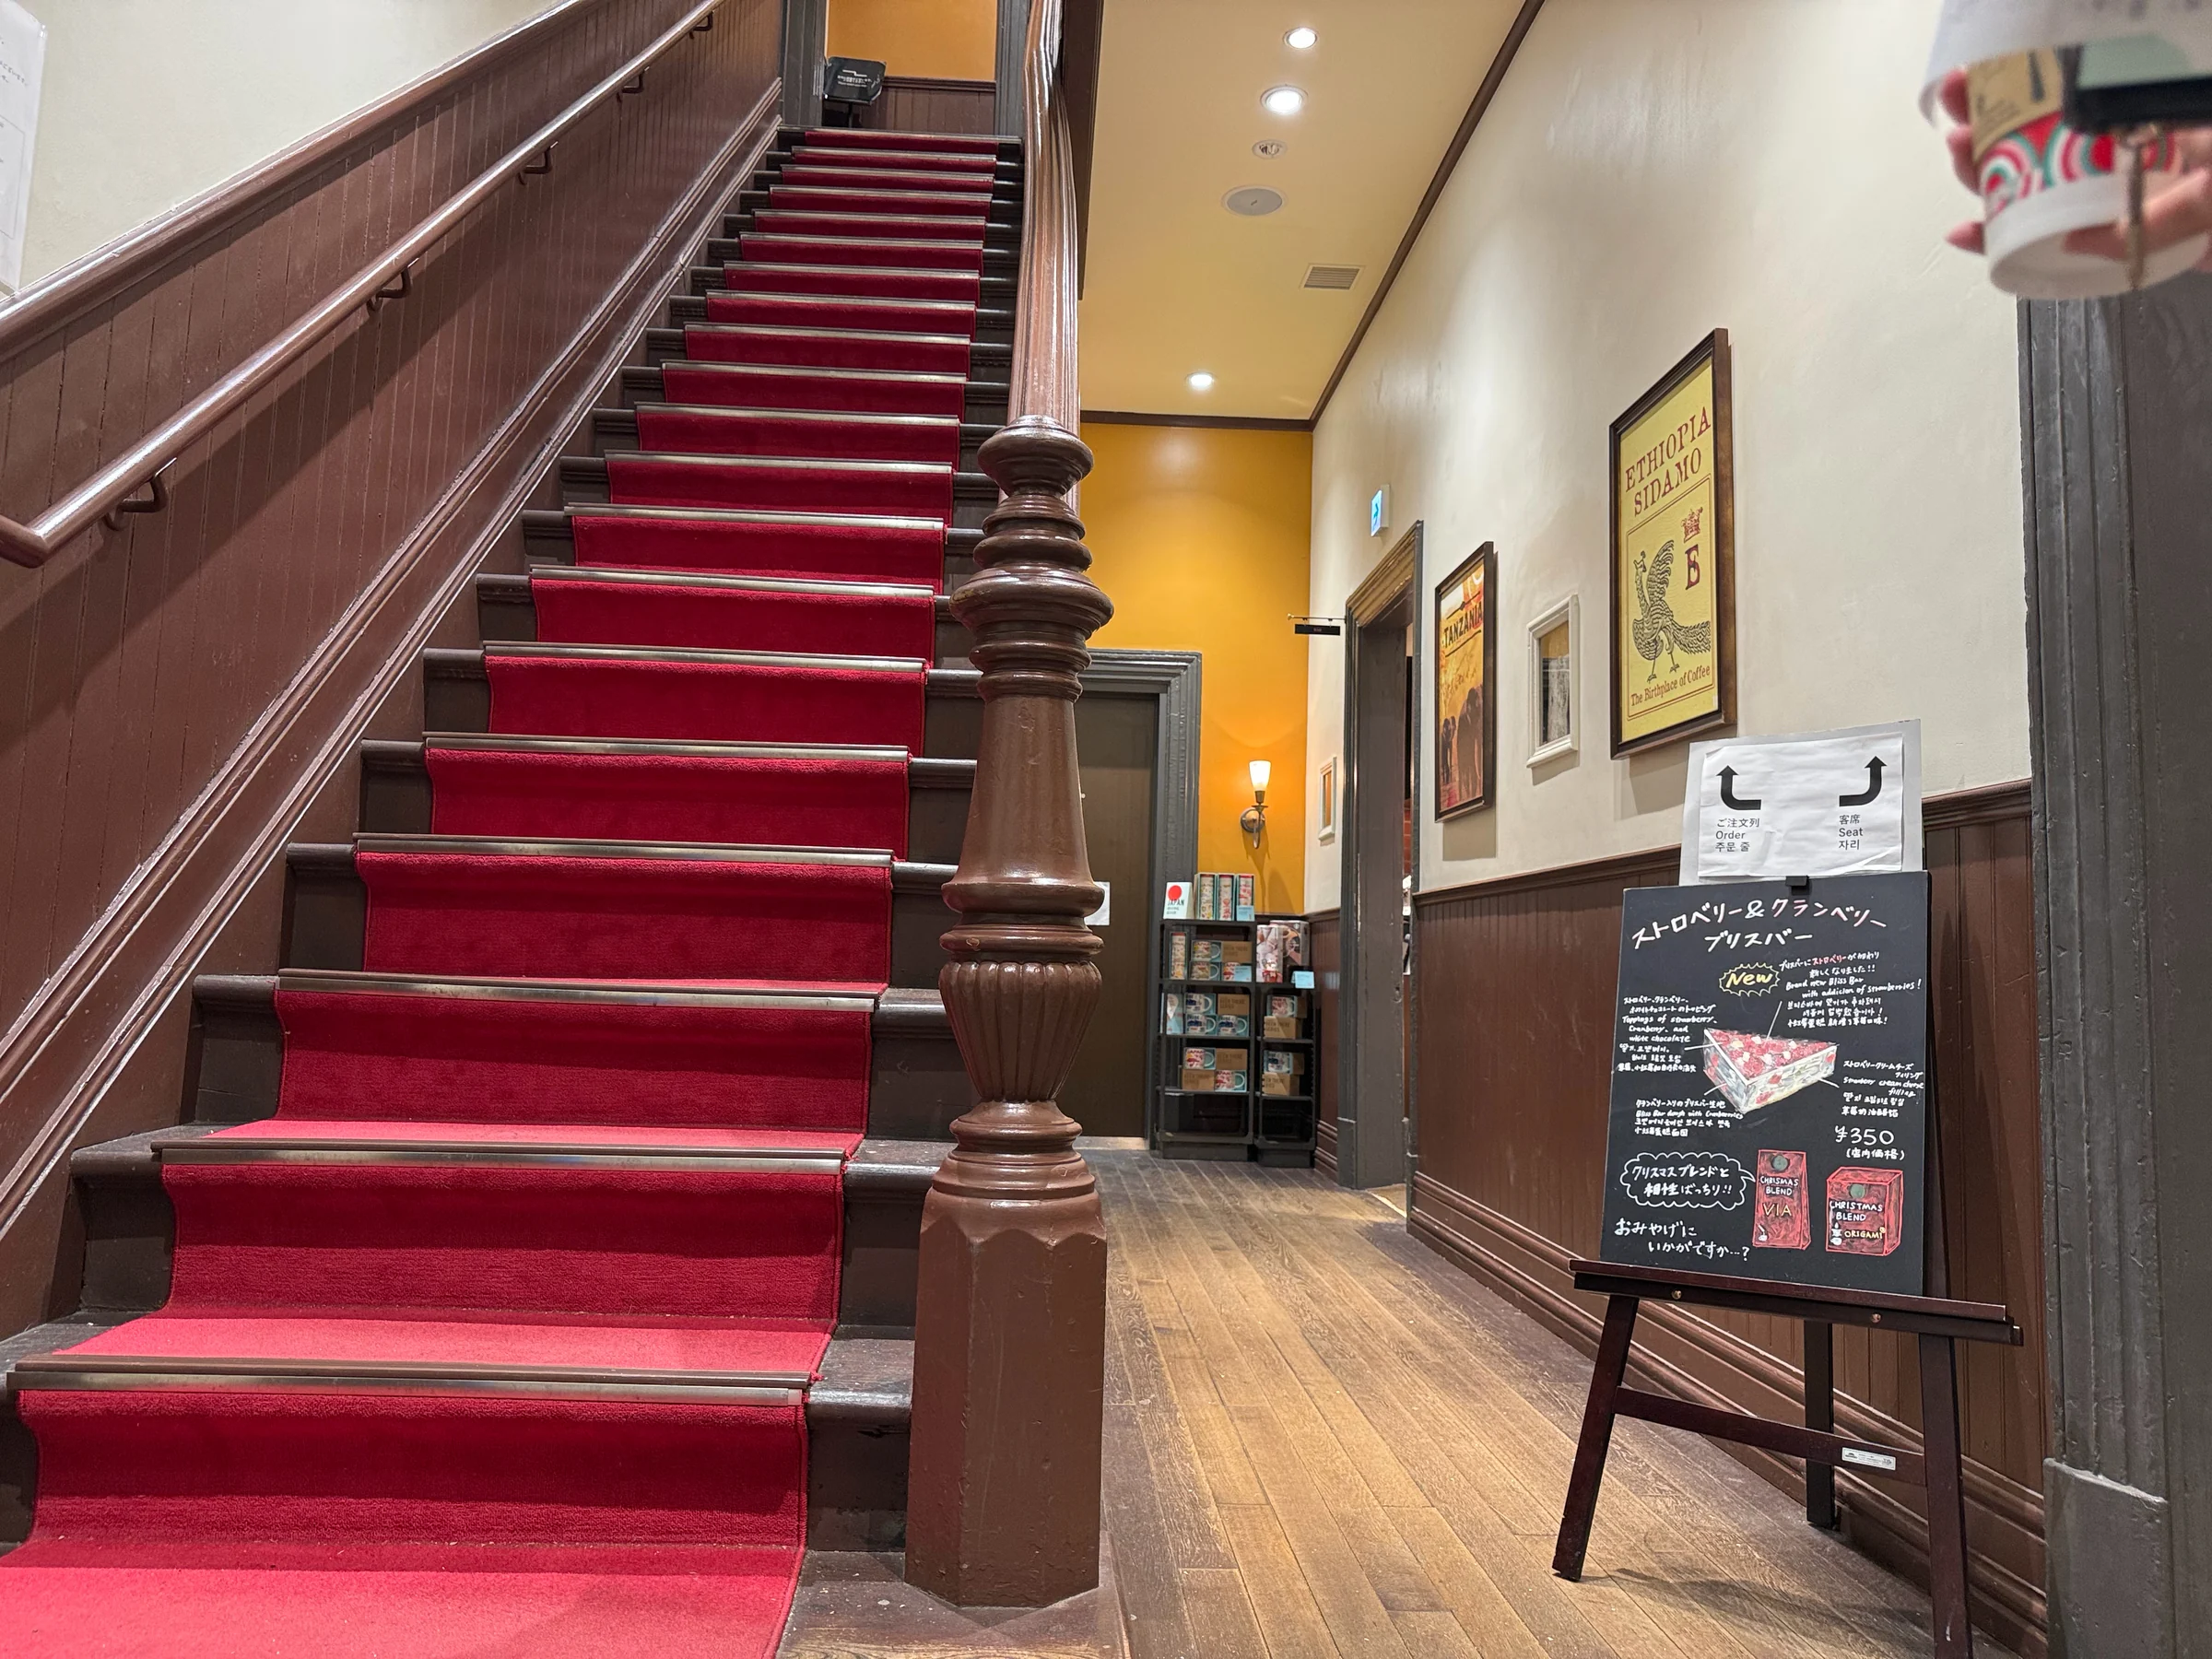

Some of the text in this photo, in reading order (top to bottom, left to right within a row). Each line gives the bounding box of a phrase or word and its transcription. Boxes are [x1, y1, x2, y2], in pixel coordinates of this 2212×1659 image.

[1626, 406, 1711, 492] ETHIOPIA
[1634, 448, 1701, 516] SIDAMO
[1444, 601, 1483, 648] TANZANIA
[1630, 665, 1711, 706] The Birthplace of Coffee
[1717, 818, 1759, 828] ご注文列
[1839, 814, 1861, 825] 客席
[1715, 830, 1746, 840] Order
[1839, 828, 1864, 837] Seat
[1715, 841, 1750, 853] 주문 줄
[1839, 840, 1860, 850] 자리
[1704, 927, 1813, 953] ブリスバー
[1725, 973, 1773, 988] New
[1785, 980, 1808, 991] Brand
[1829, 977, 1847, 985] Bliss
[1849, 976, 1864, 985] Bar
[1802, 989, 1818, 998] with
[1856, 984, 1866, 994] of
[1622, 1016, 1653, 1024] Toppings
[1657, 1014, 1667, 1024] of
[1652, 1034, 1690, 1042] chocolate
[1835, 1125, 1894, 1146] ¥350
[1632, 1164, 1729, 1181] クリスマスブレンドと
[1766, 1186, 1792, 1195] BLEND
[1763, 1203, 1792, 1217] VIA
[1830, 1201, 1883, 1212] CHRISTMAS
[1836, 1213, 1866, 1221] BLEND
[1614, 1218, 1698, 1238] おみやげに
